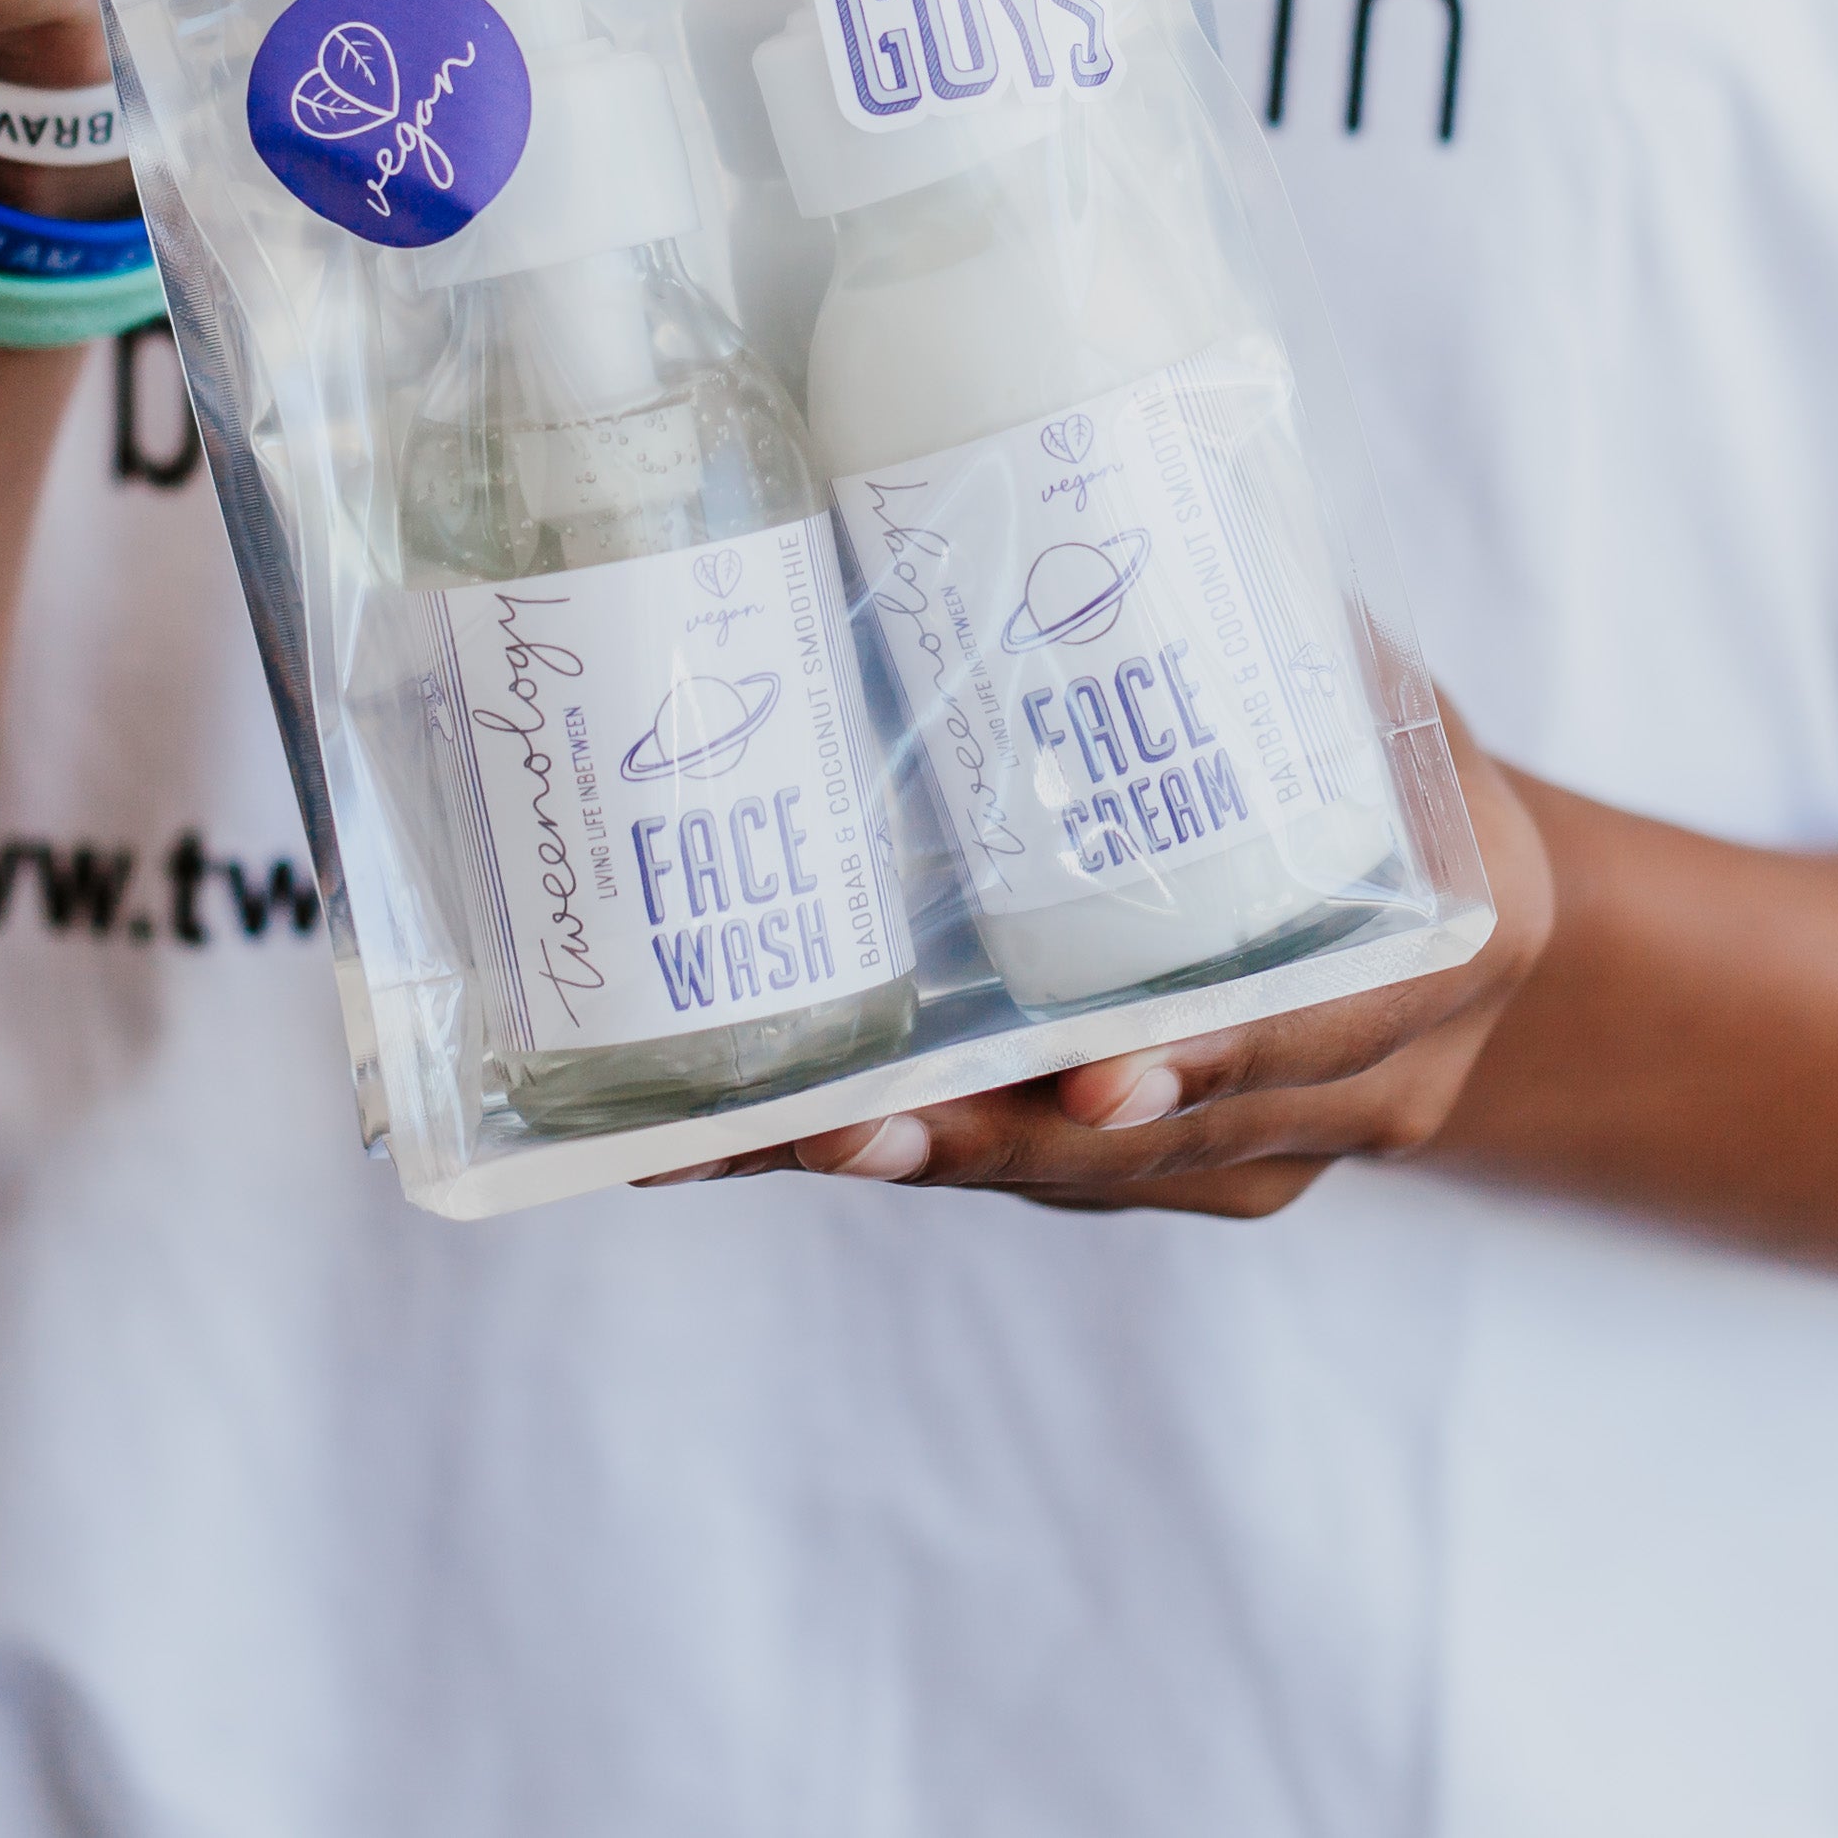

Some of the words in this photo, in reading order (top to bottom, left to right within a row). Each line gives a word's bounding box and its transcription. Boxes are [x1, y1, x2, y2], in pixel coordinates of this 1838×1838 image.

[366, 40, 476, 218] vegan
[1040, 462, 1124, 513] vegan
[685, 602, 766, 648] vegan
[777, 531, 823, 676] SMOOTHIE
[1183, 532, 1250, 658] COCONUT
[974, 679, 1001, 715] LIFE
[1021, 637, 1218, 785] FACE
[1233, 662, 1260, 685] &
[562, 704, 600, 803] INBETWEEN
[806, 687, 851, 816] COCONUT
[989, 717, 1021, 769] LIVING
[1243, 690, 1303, 805] BAOBAB
[472, 593, 605, 1028] tweenology
[582, 806, 607, 841] LIFE
[631, 785, 818, 927] FACE
[835, 825, 856, 844] &
[1061, 747, 1249, 875] CREAM
[590, 845, 618, 900] LIVING
[840, 852, 881, 970] BAOBAB
[651, 897, 836, 1012] WASH
